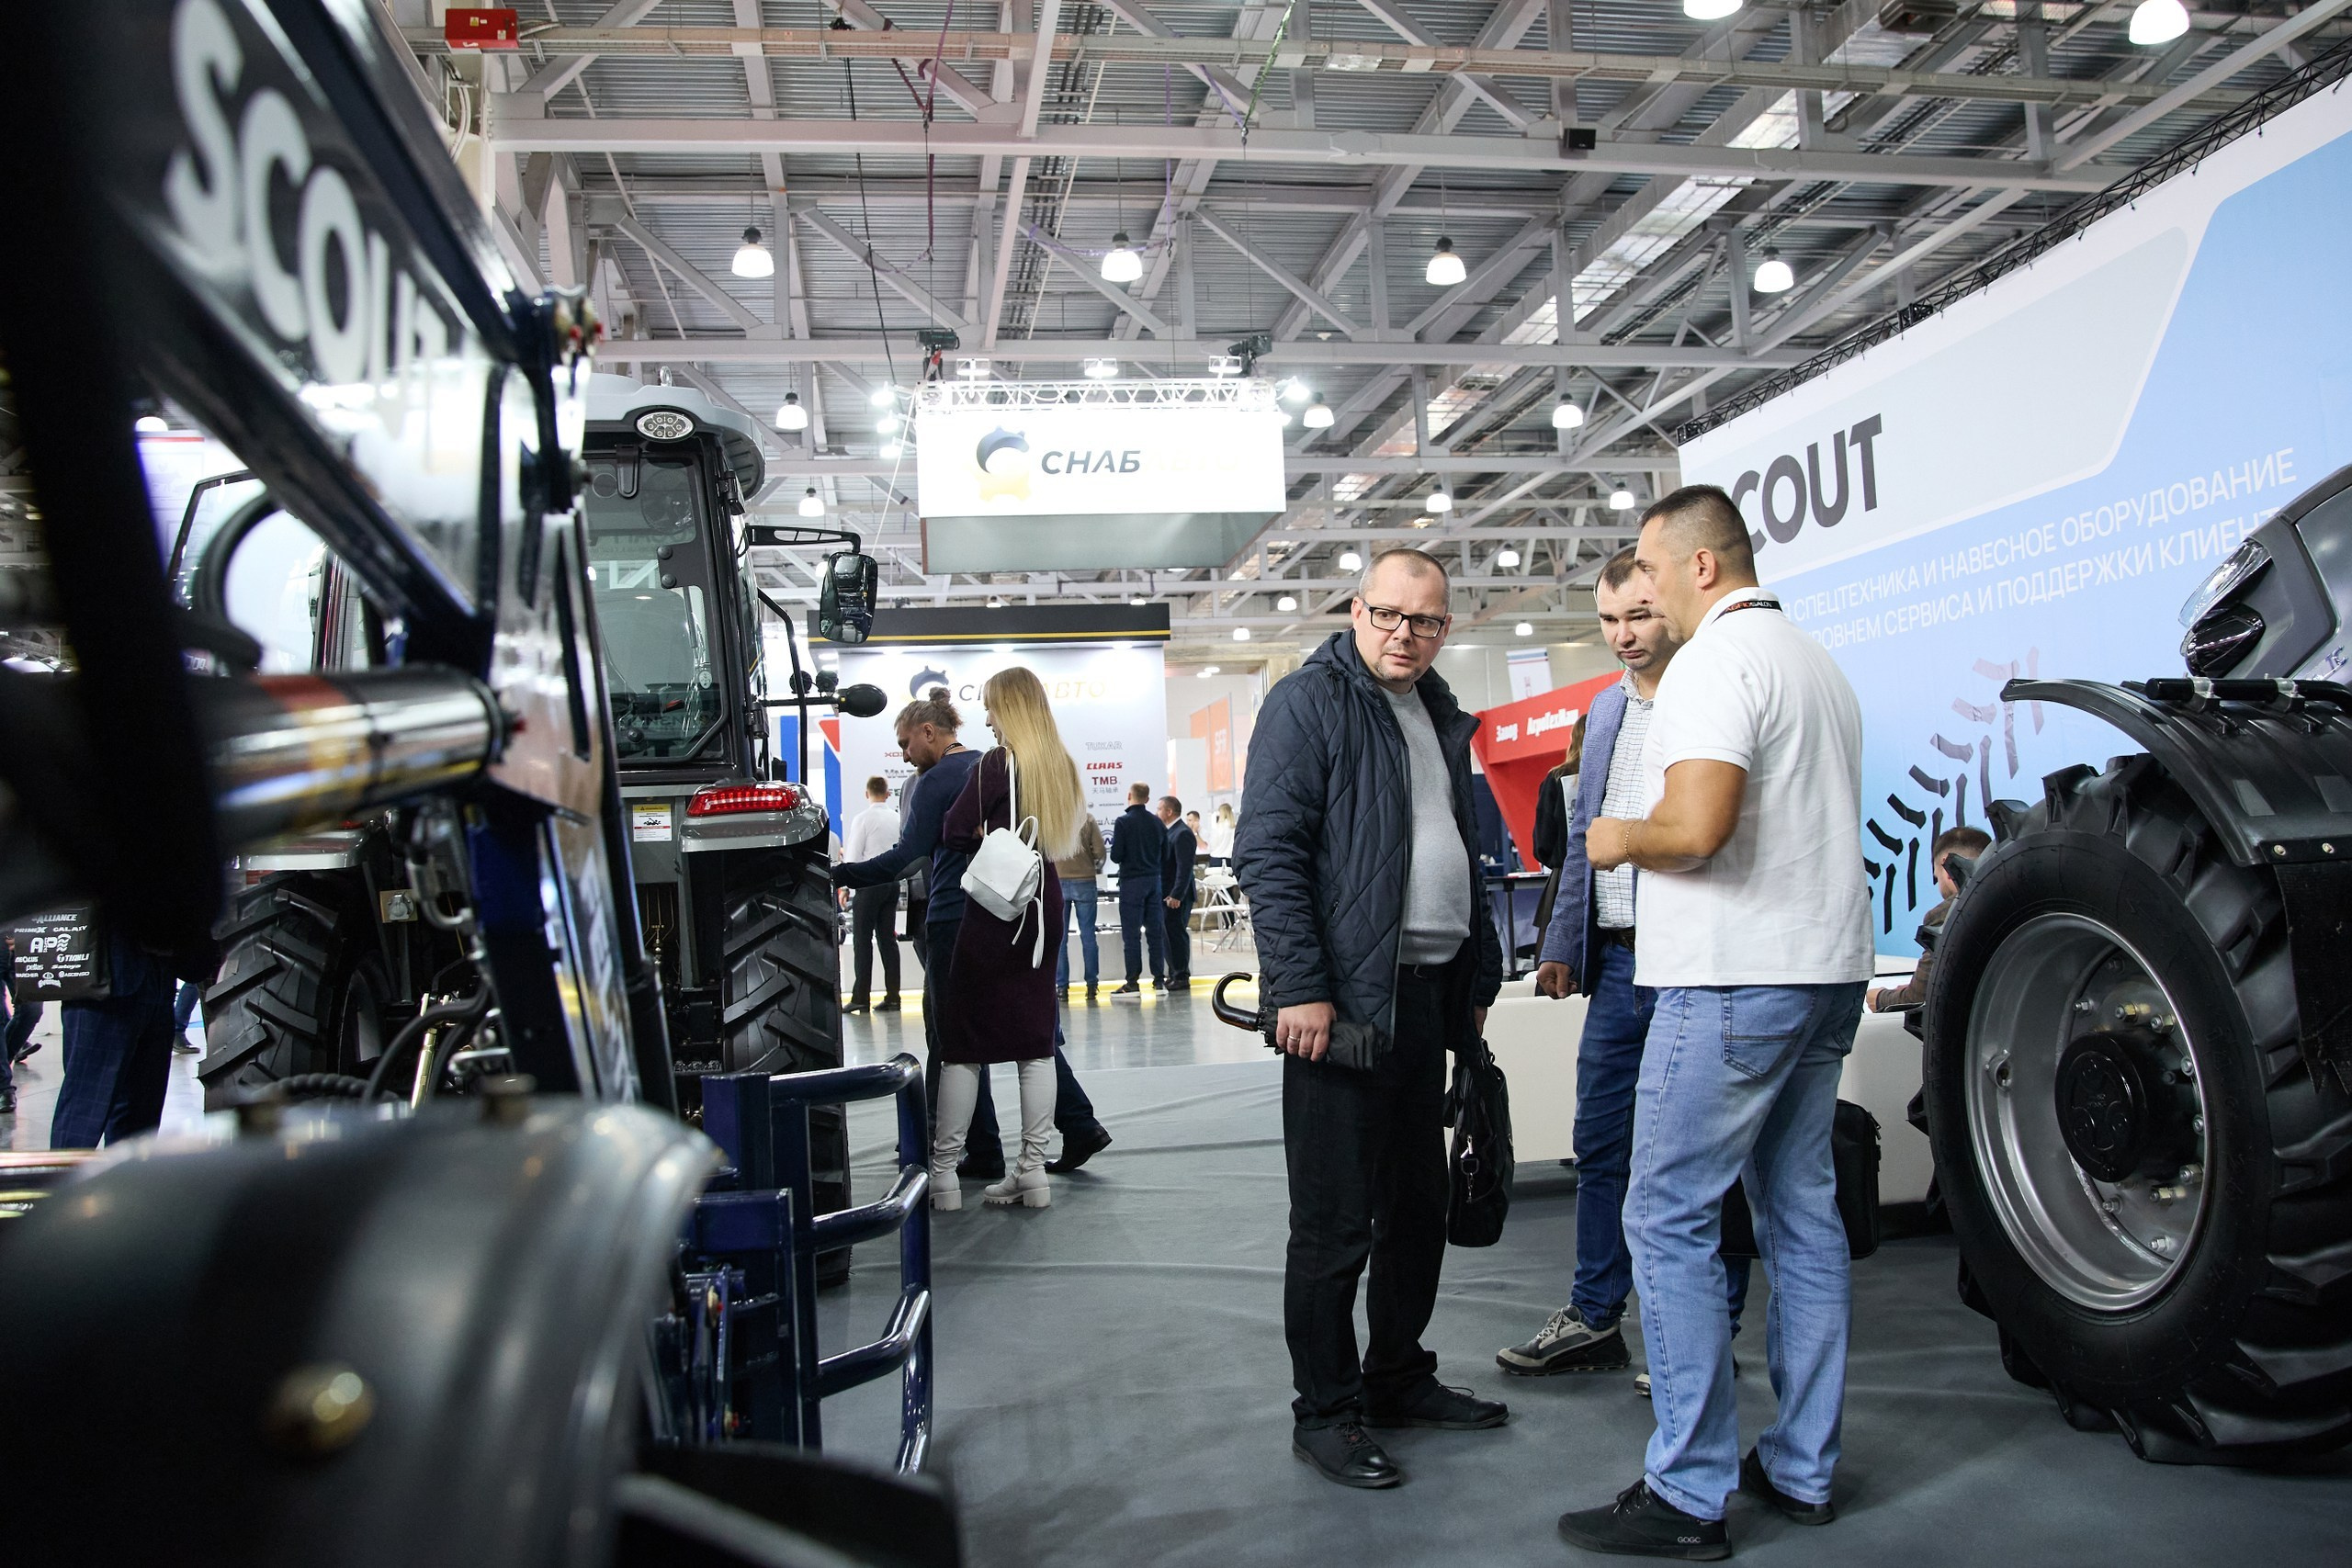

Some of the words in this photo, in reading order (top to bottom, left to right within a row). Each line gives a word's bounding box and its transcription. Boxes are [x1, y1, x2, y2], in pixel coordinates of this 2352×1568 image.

[164, 0, 448, 464] SCOUT
[1732, 412, 1883, 555] COUT
[1793, 565, 1919, 622] СПЕЦТЕХНИКА
[1923, 558, 1937, 587] И
[1941, 523, 2057, 581] НАВЕСНОЕ
[2061, 446, 2297, 547] ОБОРУДОВАНИЕ
[1809, 614, 1881, 650] РОВНЕМ
[1883, 591, 1974, 636] СЕРВИСА
[1978, 584, 1993, 614] И
[1996, 542, 2154, 610] ПОДДЕРЖКИ
[1086, 761, 1123, 770] CLAAS
[1091, 775, 1118, 785] TMB
